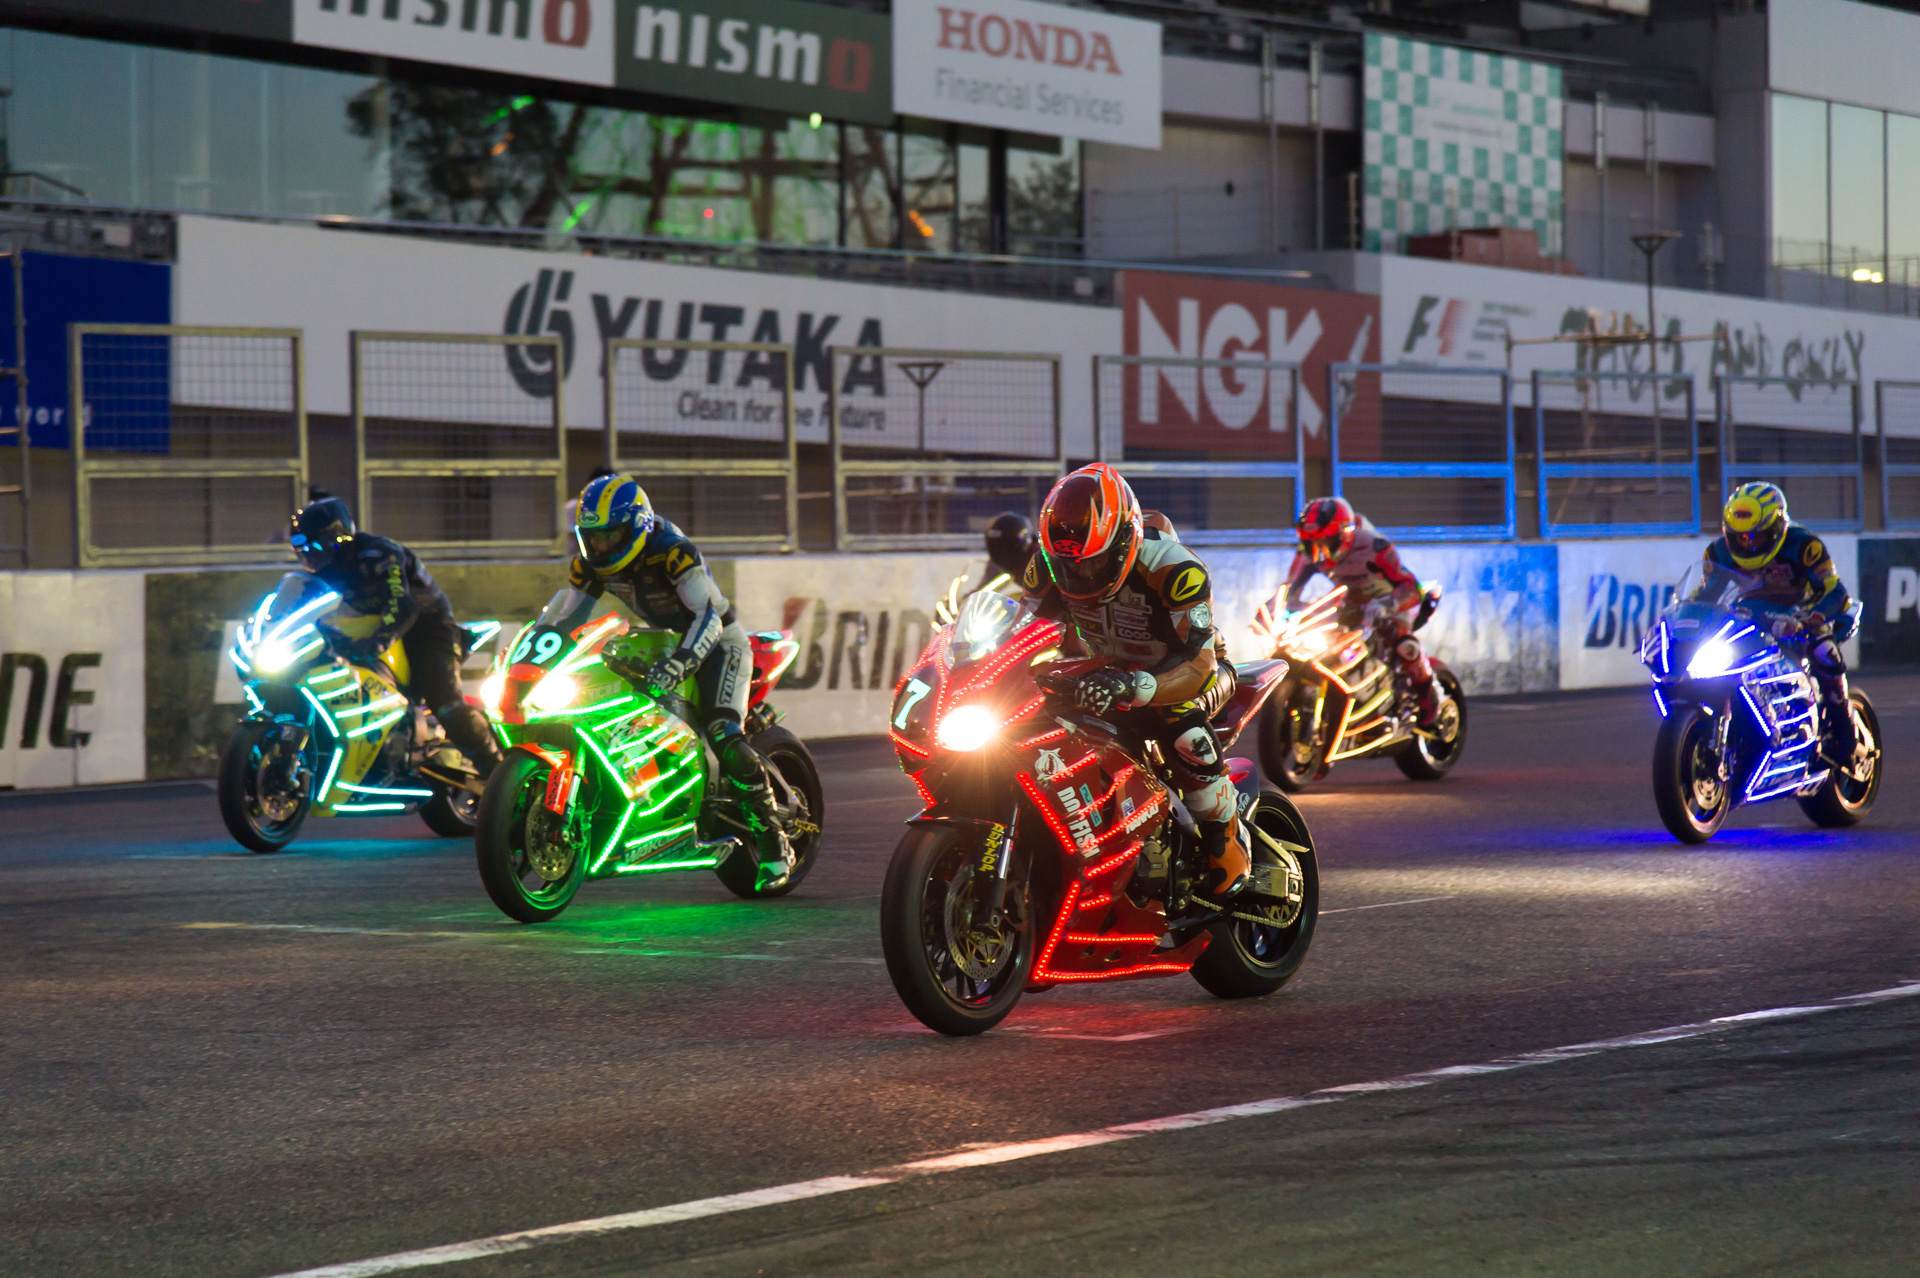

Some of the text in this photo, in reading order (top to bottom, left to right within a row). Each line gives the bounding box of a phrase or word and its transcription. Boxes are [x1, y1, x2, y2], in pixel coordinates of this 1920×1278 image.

[319, 0, 591, 48] smo
[632, 4, 873, 93] nismo
[936, 6, 1123, 76] HONDA
[936, 67, 1123, 126] Financial Services
[590, 293, 885, 397] YUTAKA
[1138, 296, 1323, 439] NGK
[677, 390, 736, 422] Clean
[742, 400, 778, 424] for
[1885, 566, 1920, 622] P
[510, 631, 563, 665] 69
[1117, 626, 1152, 641] KOOD
[720, 645, 743, 705] TAICHI
[894, 670, 932, 731] 7
[979, 822, 1005, 872] DUNLOP
